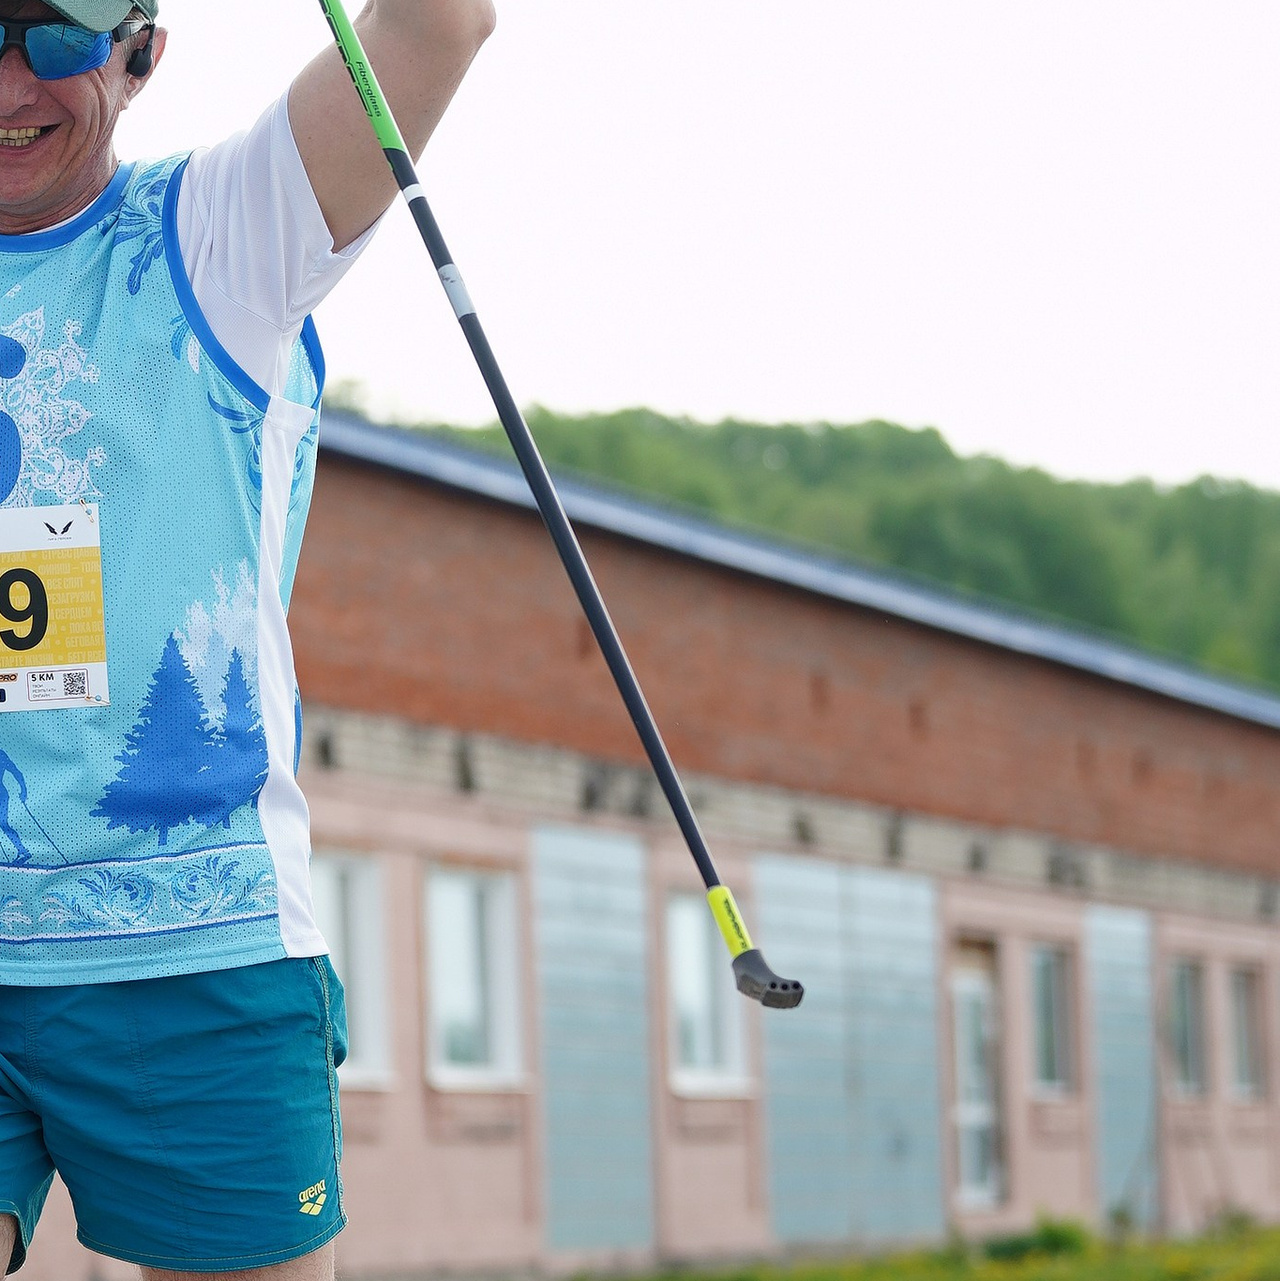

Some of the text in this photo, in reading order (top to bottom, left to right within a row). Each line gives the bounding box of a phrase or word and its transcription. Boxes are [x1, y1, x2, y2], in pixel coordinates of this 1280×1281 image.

[355, 61, 381, 118] Fiberglass
[31, 673, 37, 682] 5
[299, 1179, 326, 1203] arena
